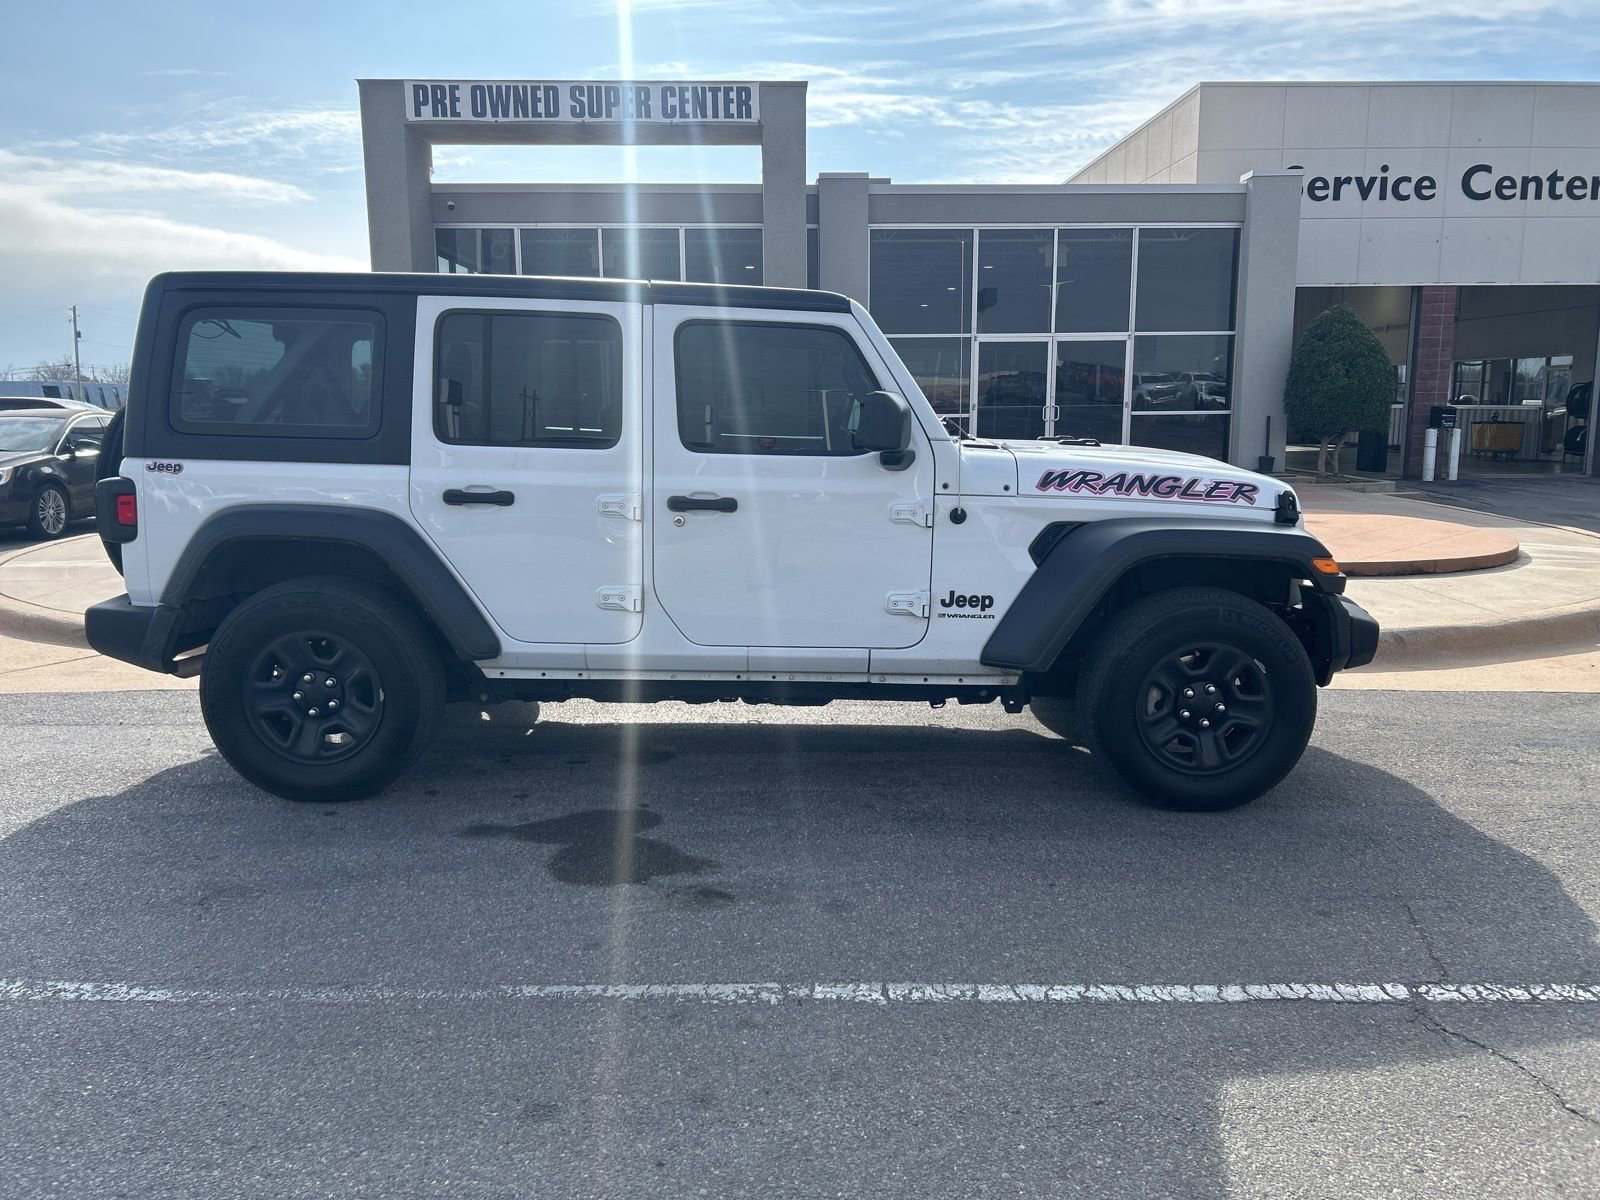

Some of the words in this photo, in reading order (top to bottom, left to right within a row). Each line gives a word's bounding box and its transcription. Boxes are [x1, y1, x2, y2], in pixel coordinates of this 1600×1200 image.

[412, 84, 462, 119] PRE
[470, 84, 560, 119] OWNED
[569, 84, 652, 119] SUPER
[660, 84, 753, 119] CENTER
[1287, 164, 1437, 201] ervice
[146, 461, 184, 475] Jeep
[1036, 469, 1260, 506] WRANGLER
[940, 590, 994, 612] Jeep
[946, 612, 996, 620] WRANGLER
